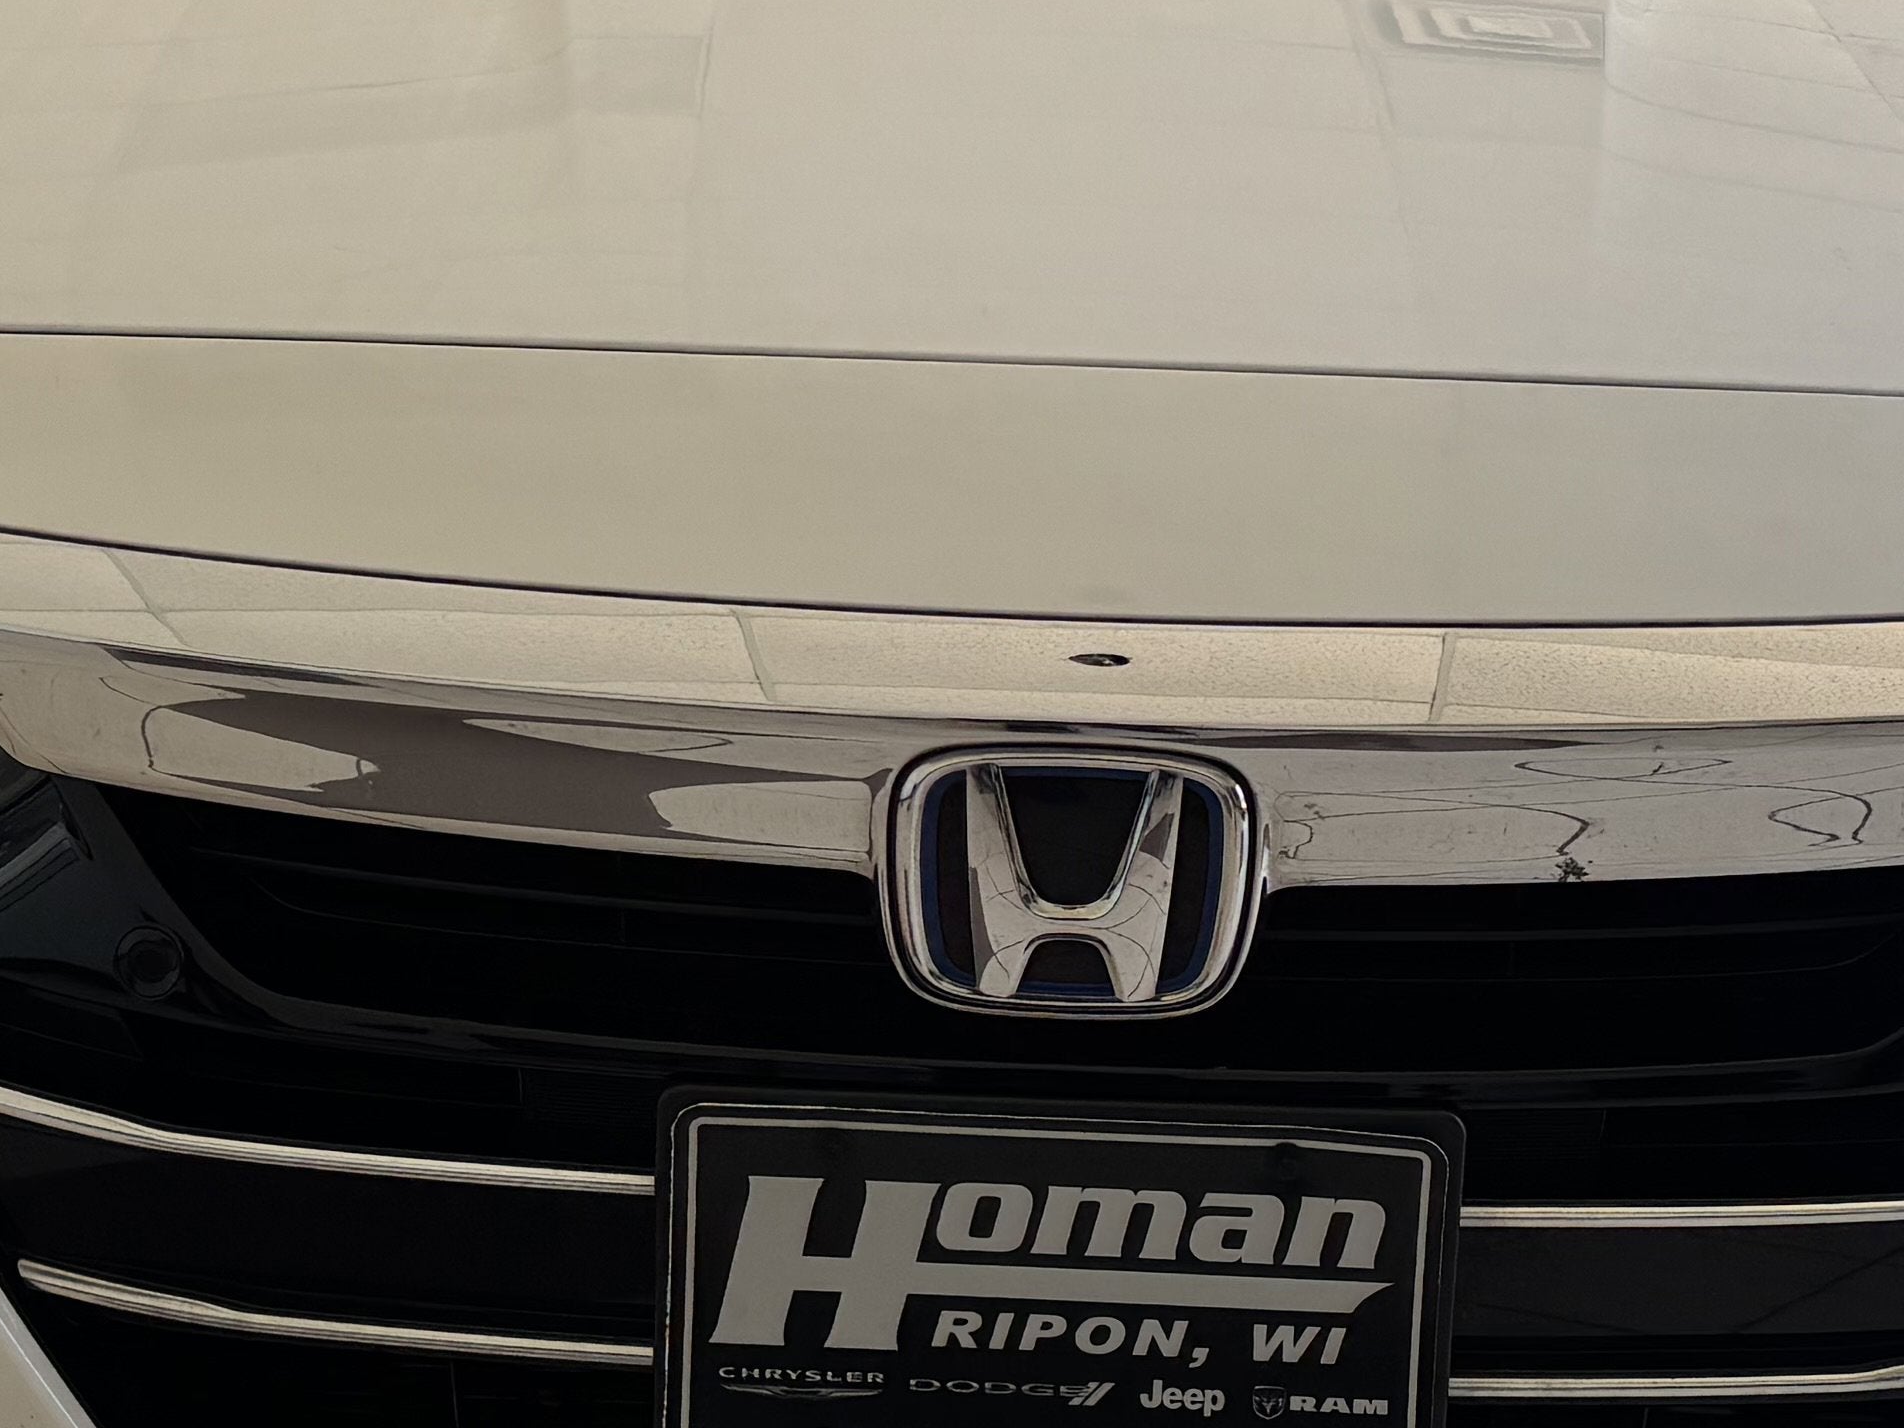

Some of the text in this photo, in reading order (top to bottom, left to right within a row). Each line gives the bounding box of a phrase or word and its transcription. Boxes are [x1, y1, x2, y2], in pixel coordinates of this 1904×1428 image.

[709, 1174, 1387, 1352] Homan
[930, 1309, 1349, 1368] RIPON, WI
[718, 1366, 1389, 1417] CHRYSLER DODGE Jeep RAM
